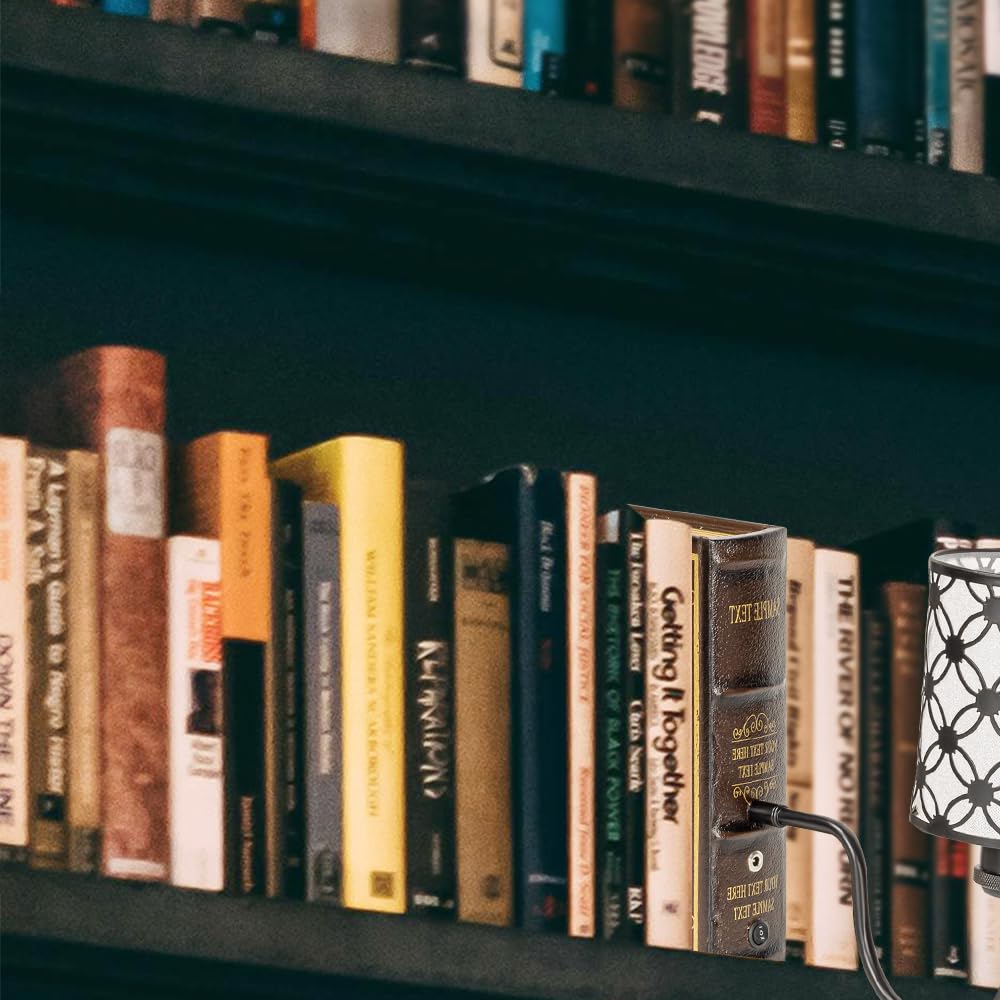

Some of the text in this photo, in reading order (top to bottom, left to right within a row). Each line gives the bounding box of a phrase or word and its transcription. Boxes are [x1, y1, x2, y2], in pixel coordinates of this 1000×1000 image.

[27, 458, 45, 511] Erwin
[629, 532, 643, 559] The
[43, 460, 64, 794] A Layman's Guide to Negro Histor
[629, 632, 643, 672] Lover
[652, 586, 685, 682] Getting
[606, 689, 620, 711] OF
[663, 687, 684, 701] It
[836, 576, 855, 794] THE RIVER OF NO
[606, 718, 620, 769] BLACK
[629, 700, 643, 741] Chris
[654, 710, 685, 825] Together
[606, 776, 620, 842] POWER
